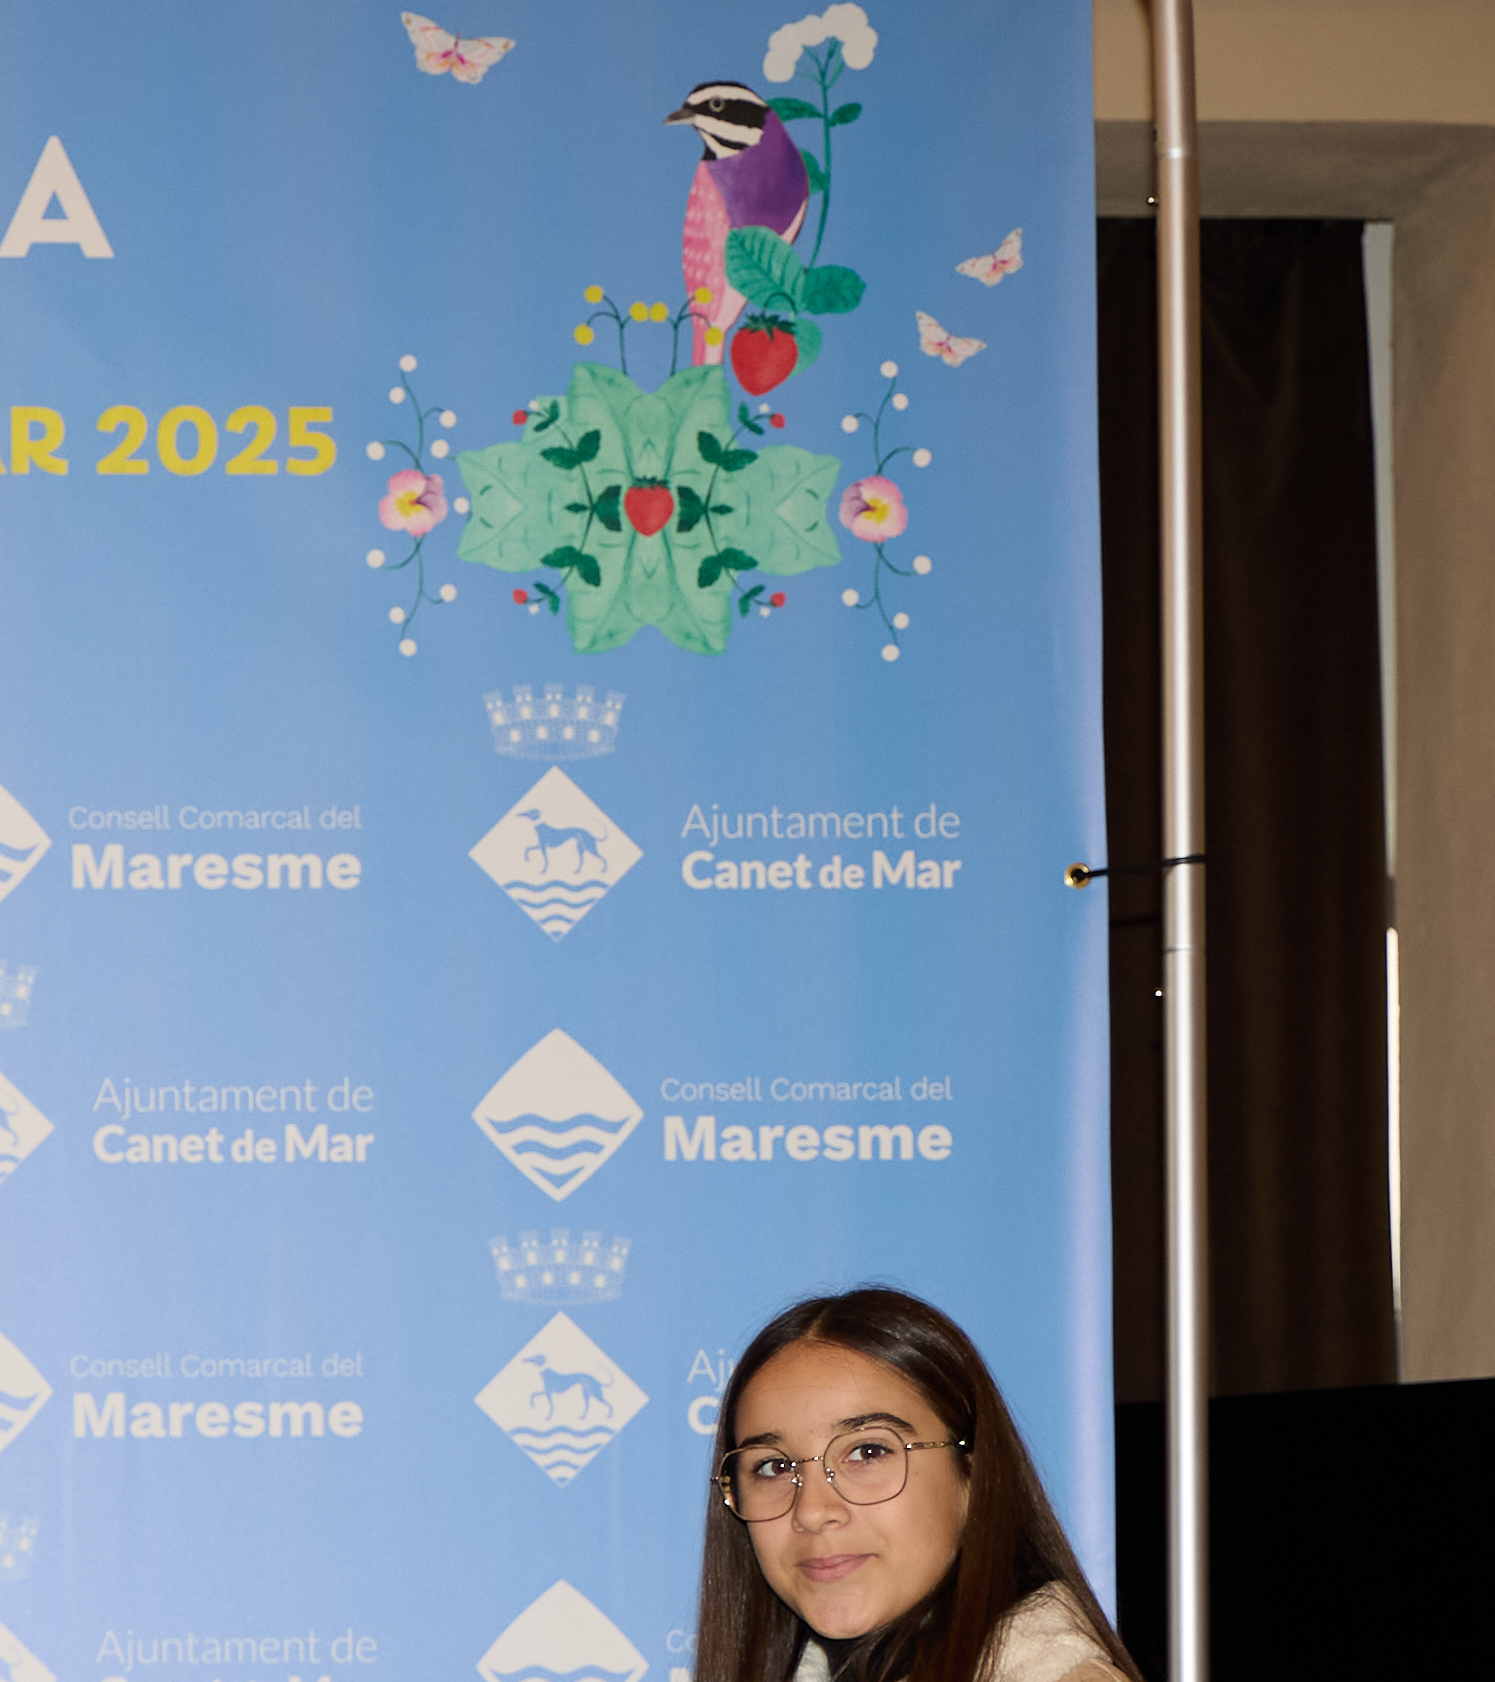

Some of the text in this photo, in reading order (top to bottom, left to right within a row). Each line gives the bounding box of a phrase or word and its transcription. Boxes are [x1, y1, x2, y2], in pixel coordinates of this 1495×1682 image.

[94, 404, 339, 475] 2025
[68, 805, 362, 830] Consell Comarcal del
[681, 804, 961, 846] Ajuntament de
[71, 844, 363, 891] Maresme
[681, 850, 962, 889] Canet de Mar
[93, 1077, 374, 1120] Ajuntament de
[660, 1076, 952, 1103] Consell Comarcal del
[93, 1123, 374, 1164] Canet de Mar
[664, 1116, 953, 1162] Maresme
[70, 1352, 364, 1378] Consell Comarcal del
[73, 1393, 364, 1438] Maresme
[96, 1629, 378, 1672] Ajuntament de
